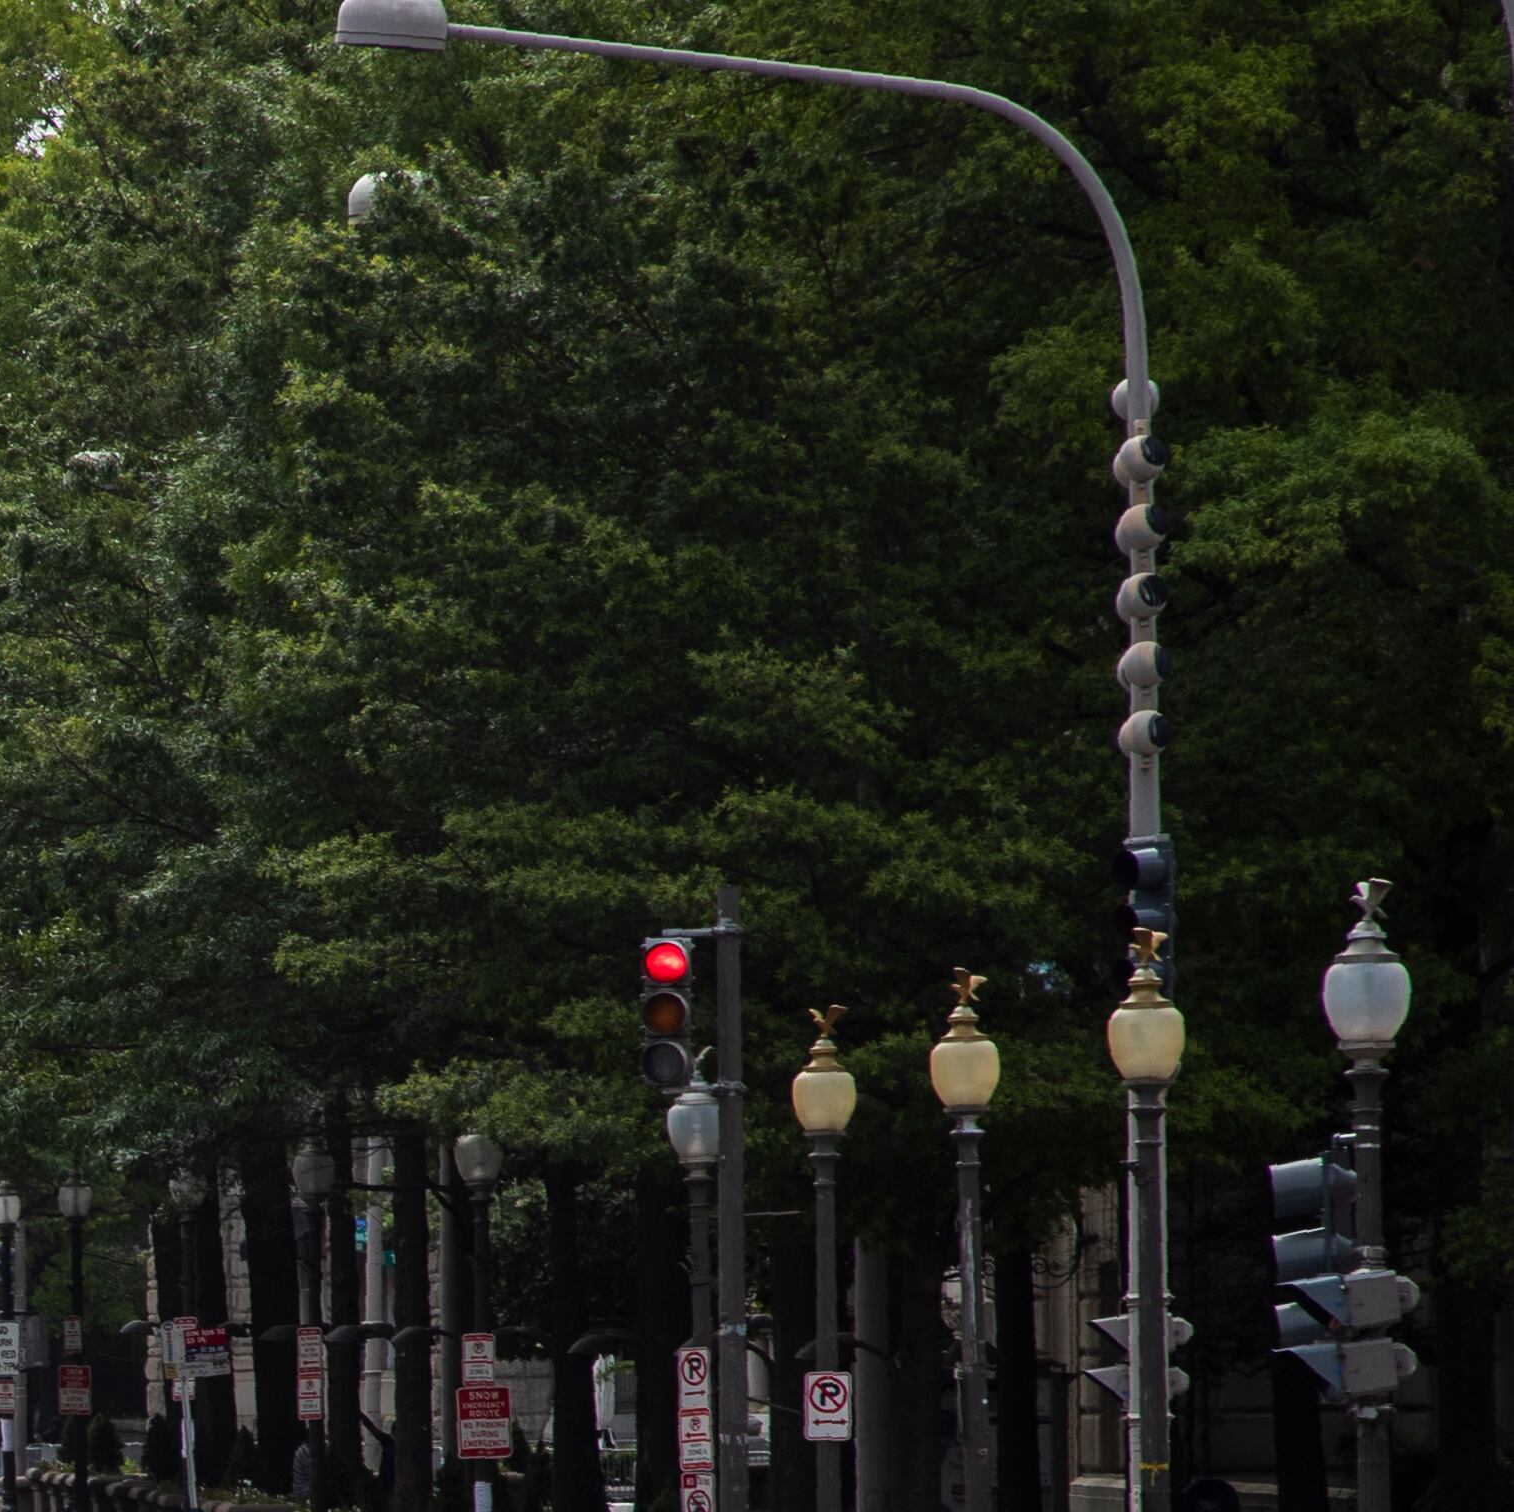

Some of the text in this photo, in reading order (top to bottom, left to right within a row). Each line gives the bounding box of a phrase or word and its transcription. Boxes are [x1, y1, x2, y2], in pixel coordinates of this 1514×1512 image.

[1, 1350, 16, 1359] RED
[468, 1391, 499, 1400] SNOW
[462, 1401, 506, 1409] EMERGENCY
[468, 1409, 501, 1417] ROUTE
[471, 1430, 499, 1438] DURING
